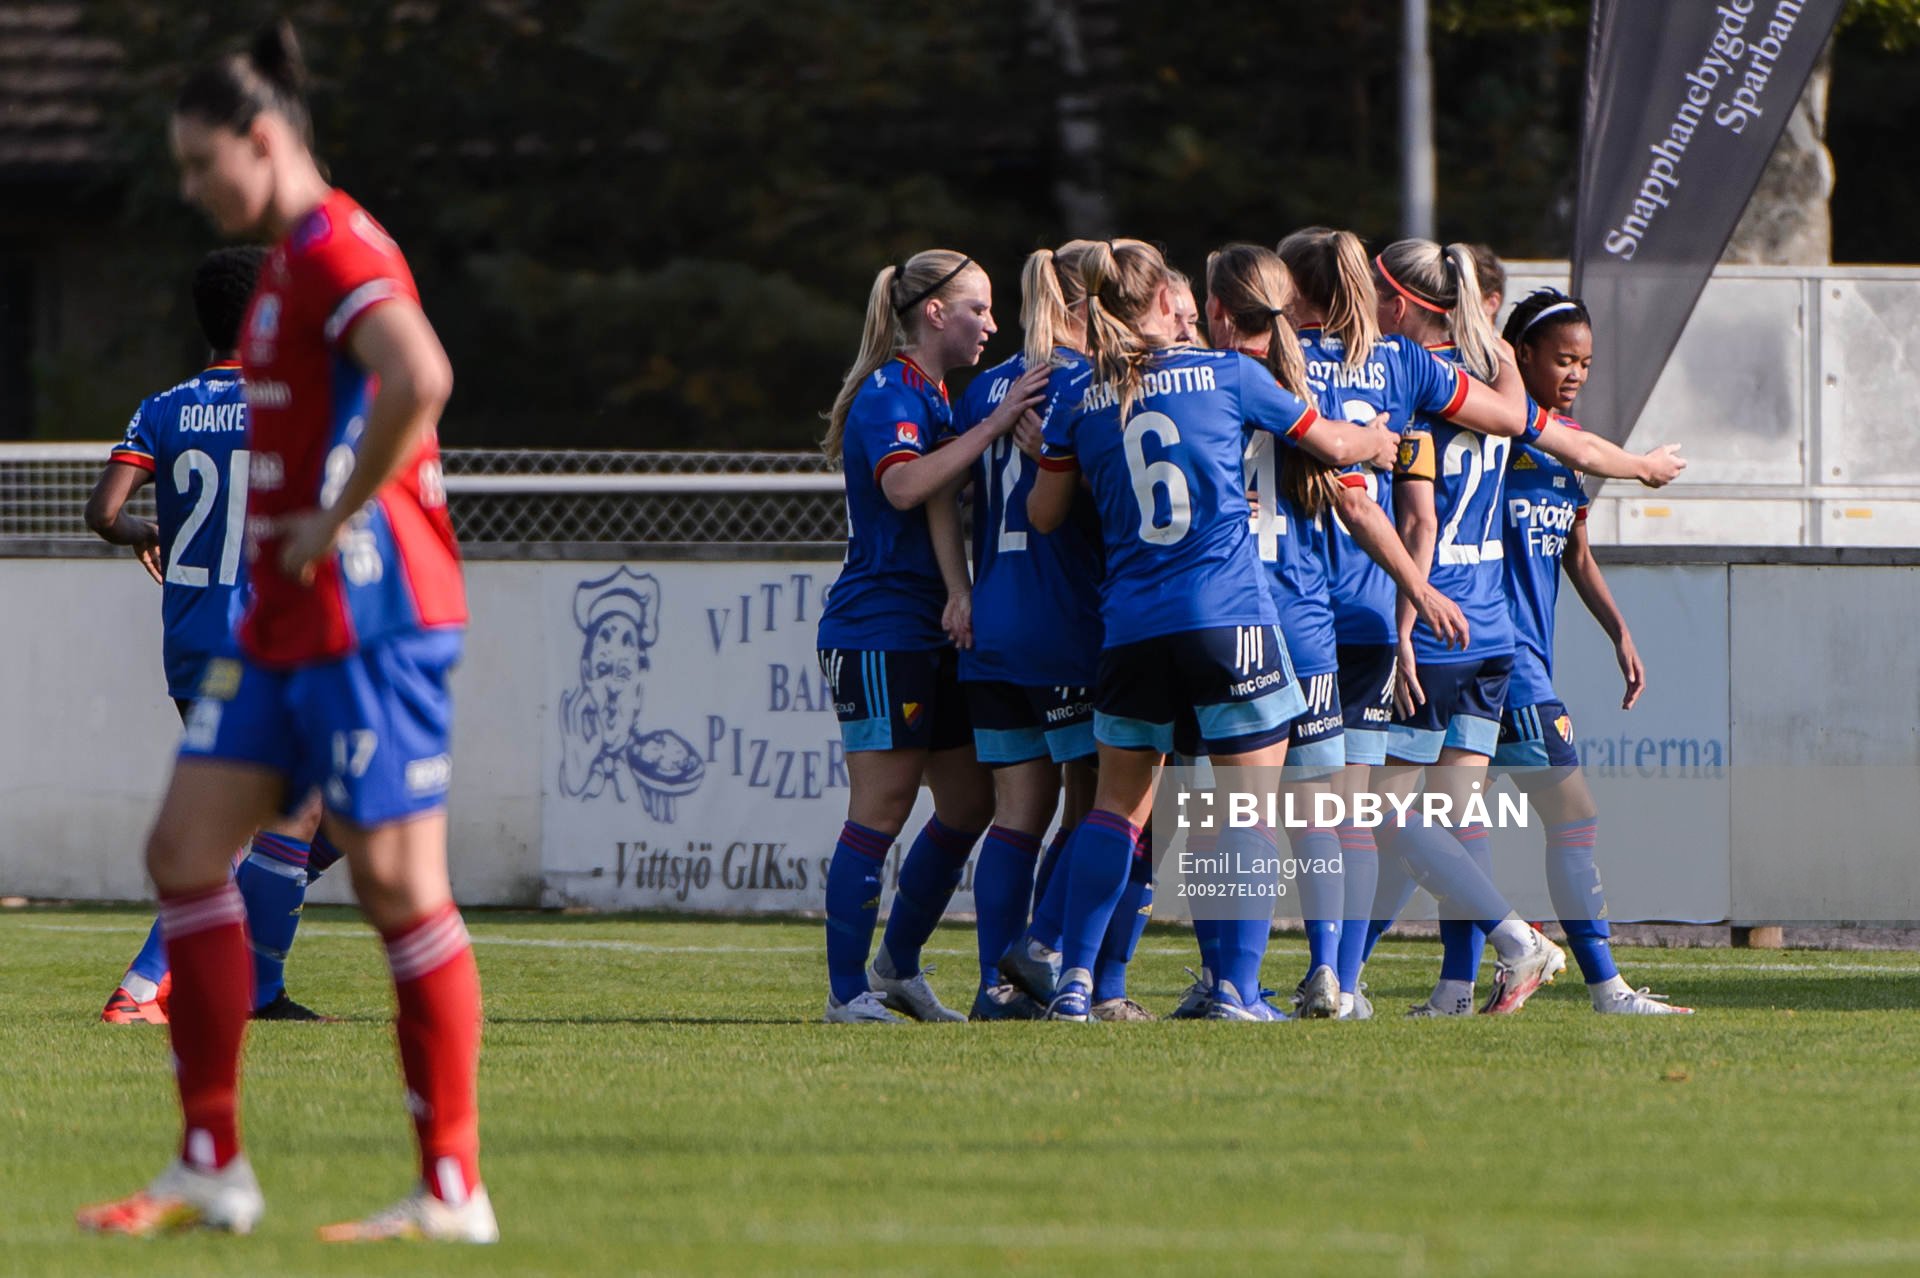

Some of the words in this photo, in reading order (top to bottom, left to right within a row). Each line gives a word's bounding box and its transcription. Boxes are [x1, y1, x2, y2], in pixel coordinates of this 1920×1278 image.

[1714, 0, 1806, 134] Sparban
[1083, 366, 1216, 414] ARNDOTTIR
[179, 402, 248, 433] BOAKYE
[1123, 411, 1191, 546] 6
[1438, 431, 1511, 565] 22
[166, 449, 250, 588] 21
[1230, 681, 1256, 696] NRC
[1255, 670, 1281, 689] Group
[1046, 705, 1075, 723] NRC
[1297, 719, 1325, 738] NRC
[1363, 706, 1385, 722] NRC
[706, 715, 849, 799] PIZZER
[616, 842, 712, 902] Vittsjö
[721, 842, 808, 890] GIK:s
